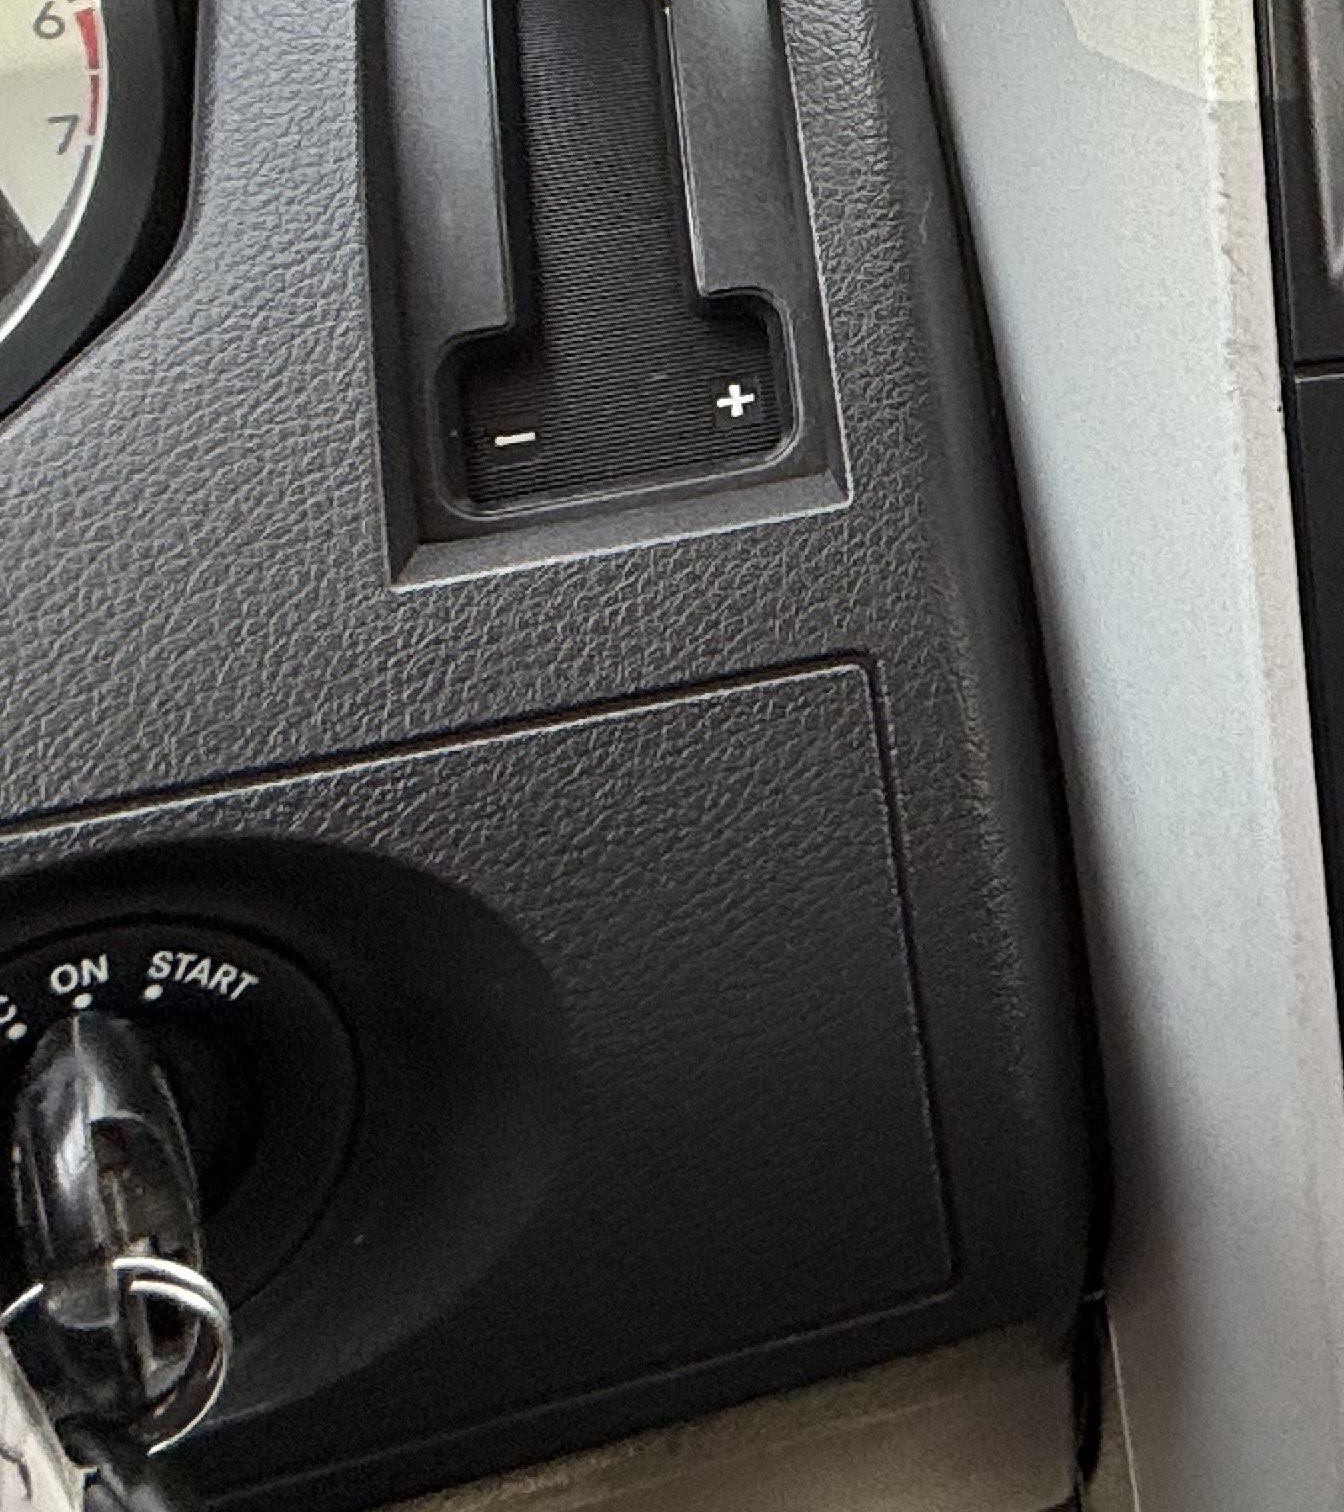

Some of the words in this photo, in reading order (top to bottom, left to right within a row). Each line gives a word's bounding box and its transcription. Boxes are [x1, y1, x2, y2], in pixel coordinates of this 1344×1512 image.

[32, 0, 66, 40] 6
[47, 113, 81, 156] 7
[49, 952, 110, 996] ON
[146, 949, 260, 1002] START
